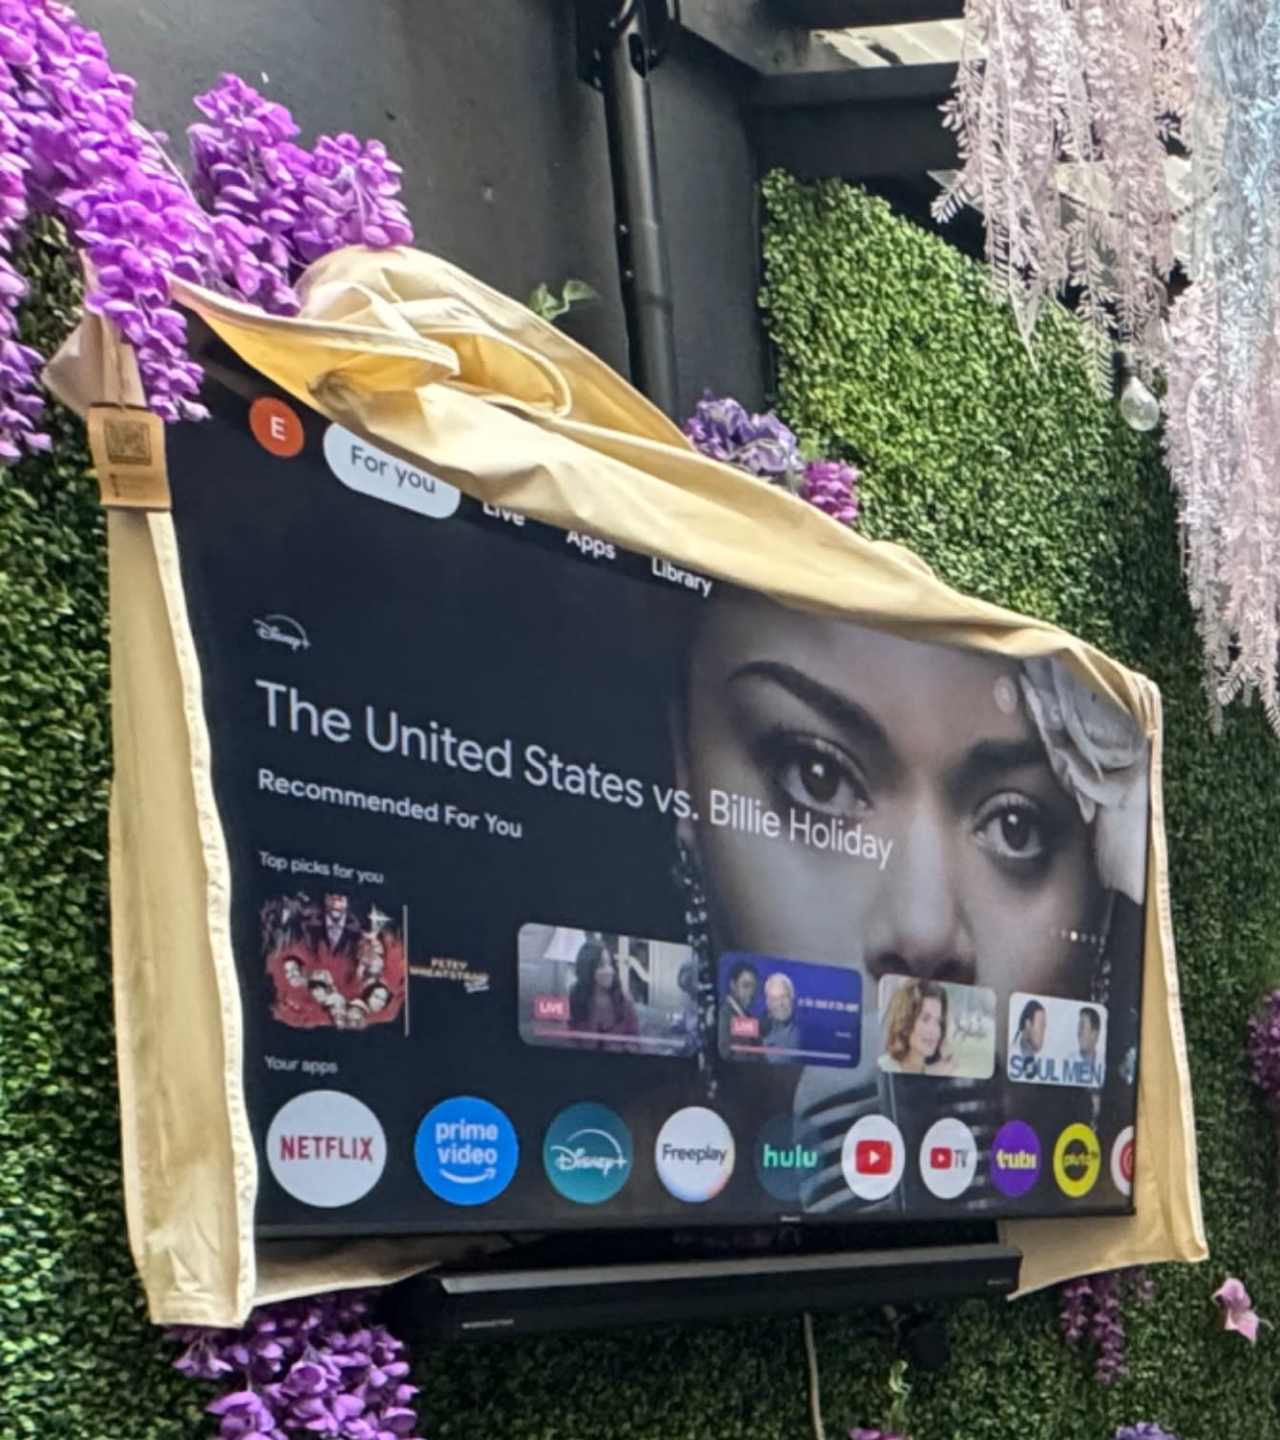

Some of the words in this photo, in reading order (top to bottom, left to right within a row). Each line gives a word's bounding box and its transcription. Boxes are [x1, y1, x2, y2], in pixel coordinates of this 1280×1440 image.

[270, 416, 286, 441] E
[349, 445, 387, 476] For
[394, 464, 437, 495] you
[566, 530, 617, 560] Apps
[651, 556, 713, 598] Library
[255, 678, 352, 743] The
[365, 705, 513, 779] United
[524, 744, 644, 808] States
[652, 784, 700, 821] vs.
[709, 789, 781, 838] Billie
[789, 807, 894, 871] Holiday
[257, 767, 440, 823] Recommended
[444, 804, 480, 830] For
[484, 812, 523, 839] You
[259, 851, 288, 872] Top
[290, 858, 331, 876] picks
[332, 863, 354, 879] for
[356, 869, 385, 885] you
[538, 1000, 565, 1015] LIVE
[264, 1055, 298, 1071] Your
[301, 1058, 338, 1075] apps
[1009, 1054, 1058, 1082] SOUL
[1062, 1059, 1102, 1085] MEN
[435, 1118, 499, 1144] prime
[280, 1135, 374, 1162] NETFLIX
[437, 1142, 498, 1165] video
[662, 1143, 728, 1166] Freeplay
[762, 1144, 818, 1169] hulu
[953, 1150, 969, 1168] TV
[996, 1149, 1037, 1169] tubi
